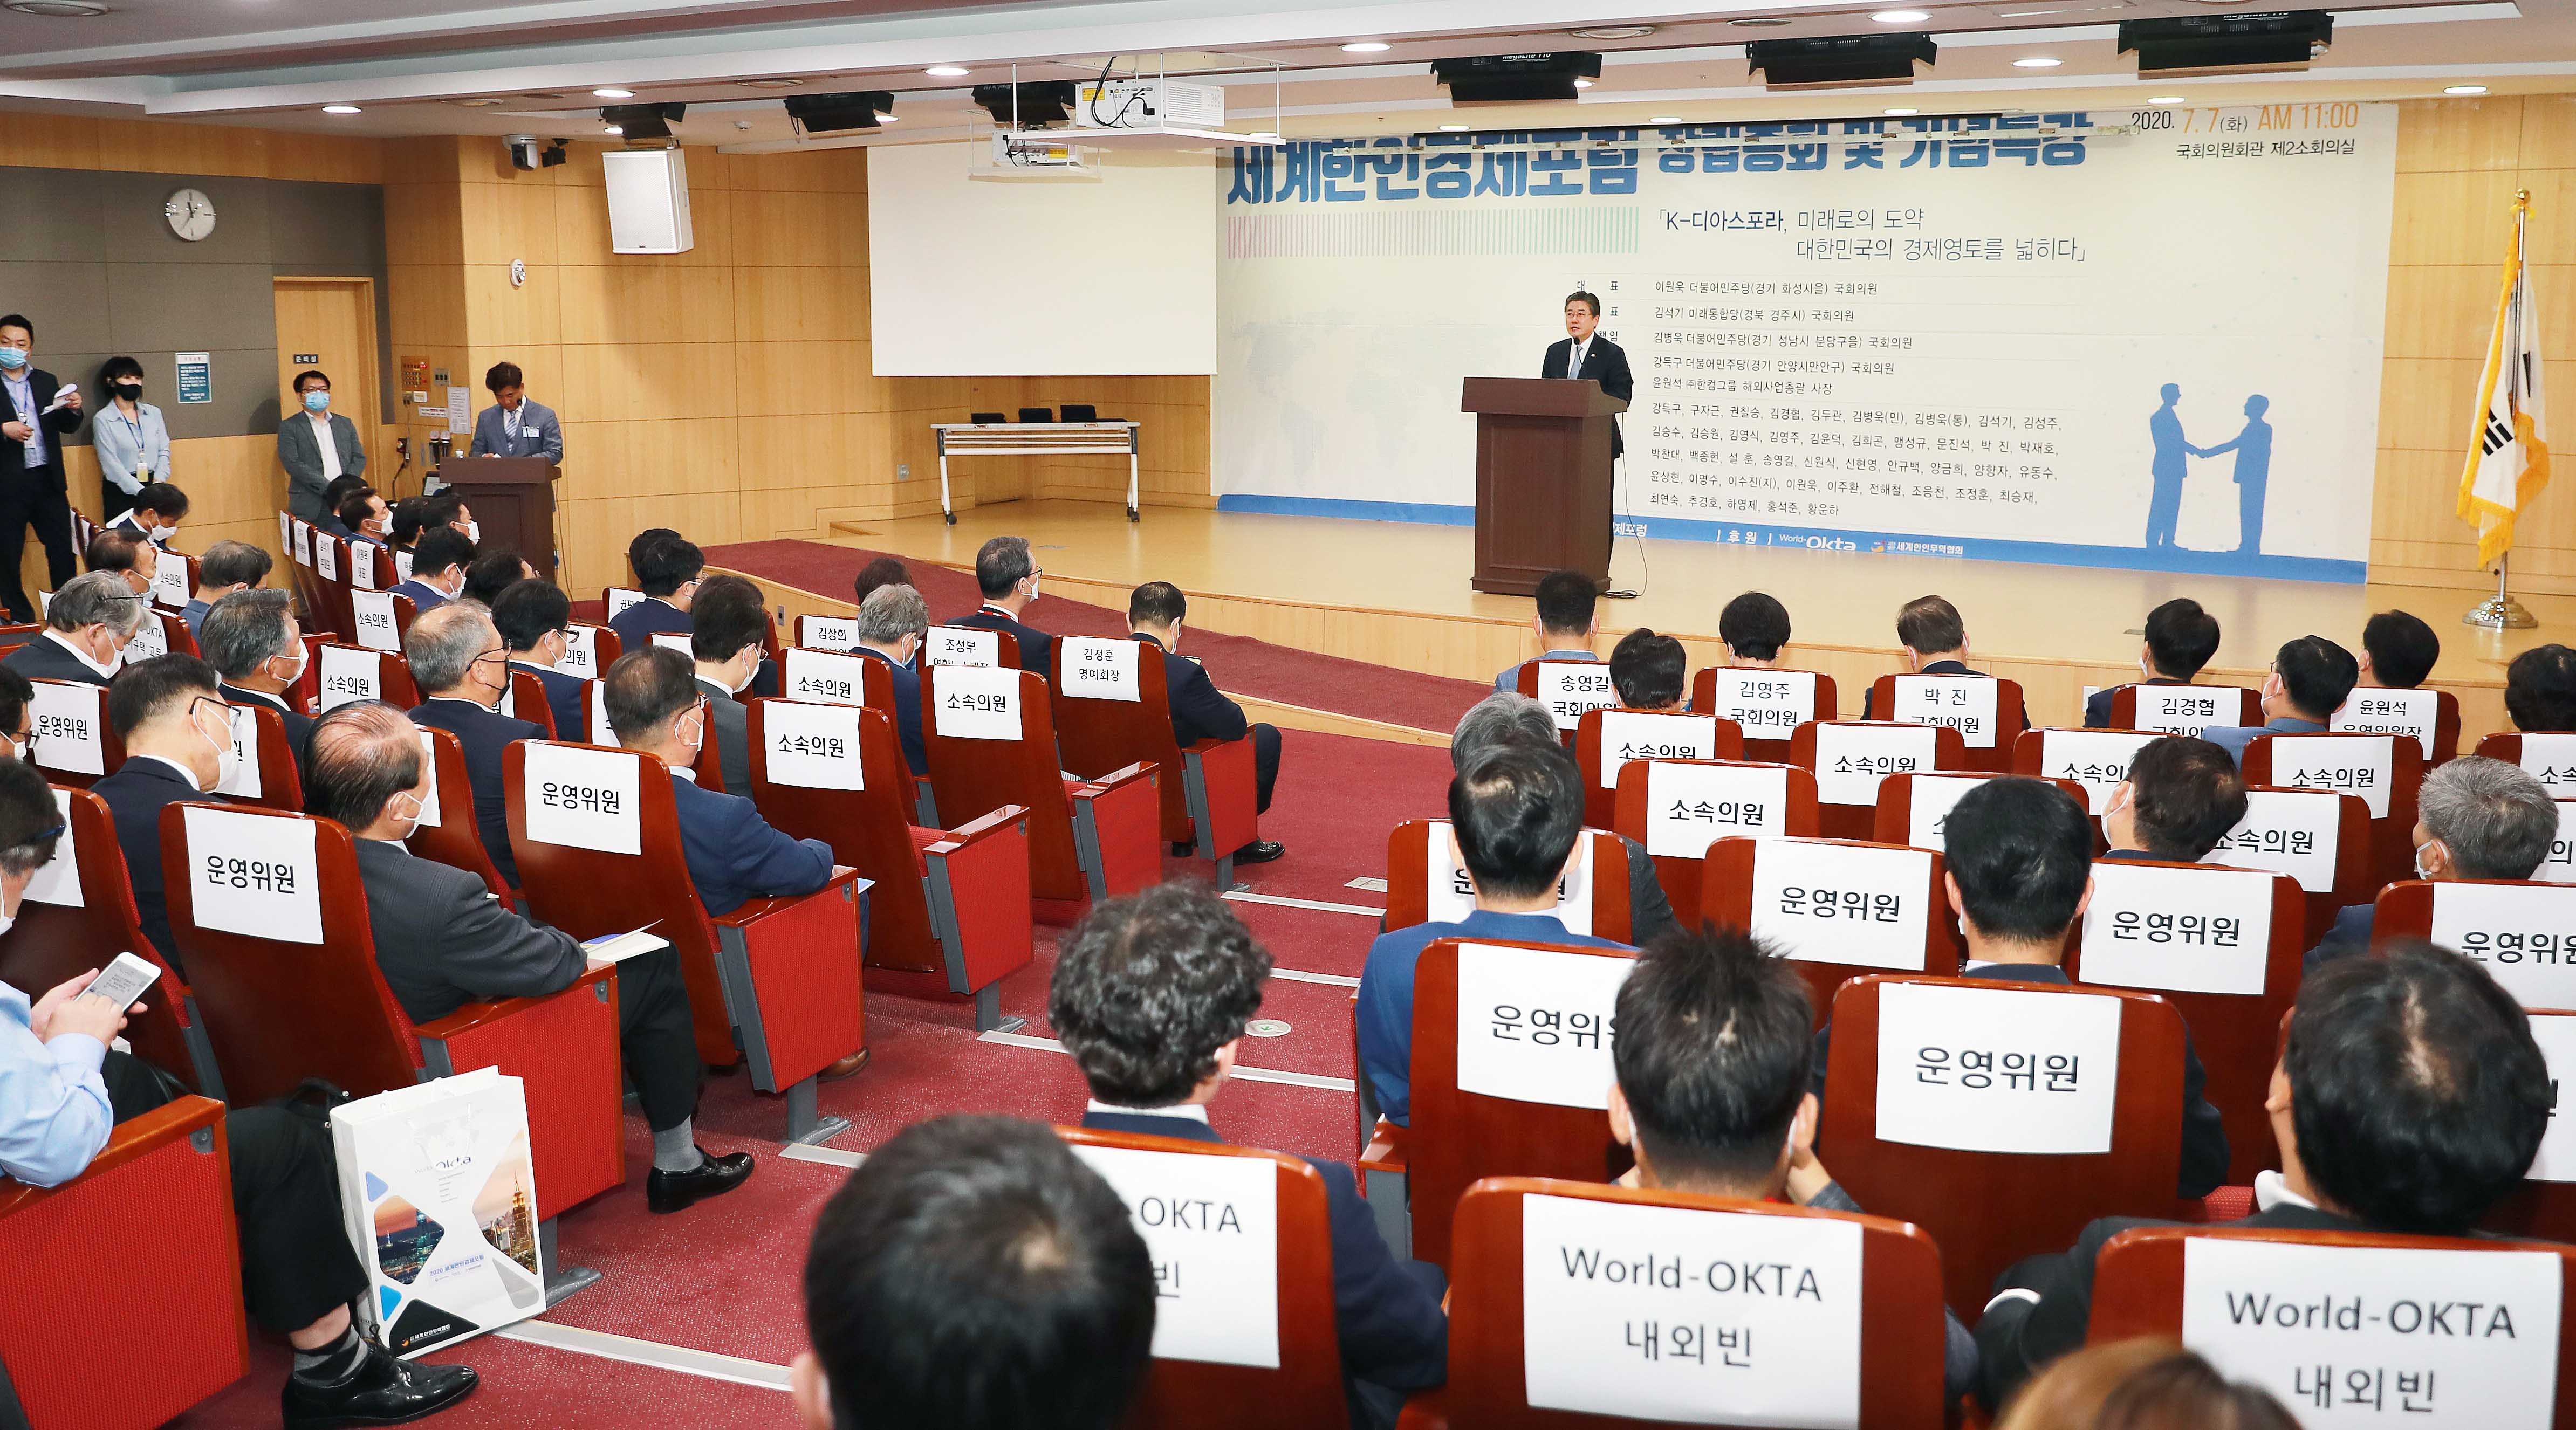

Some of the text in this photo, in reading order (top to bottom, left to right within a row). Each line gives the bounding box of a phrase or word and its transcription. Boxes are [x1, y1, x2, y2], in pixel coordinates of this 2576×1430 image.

[2132, 111, 2175, 130] 2020.
[2257, 105, 2291, 130] AM
[2301, 103, 2359, 129] 11:00
[2176, 139, 2355, 159] 국회의원회관 제2소회의실
[1799, 209, 1874, 231] 미래로의
[1883, 208, 1924, 230] 도약
[1797, 238, 1892, 260] 대한민국의
[1903, 238, 2004, 261] 경제영토를
[1655, 281, 1877, 295] 이원욱 더불어민주당(경기 화성시을) 국회의원
[1655, 307, 1854, 322] 김석기 미래통합당(경북 경주시) 국회의원
[1655, 332, 1912, 349] 김병욱 더불어민주당(경기 성남시 분당구을) 국회의원
[1654, 356, 1894, 375] 강득구 더불어민주당(경기 안양시만안구) 국회의원
[1653, 377, 1681, 389] 윤원석
[1743, 381, 1805, 394] 해외사업총괄
[1811, 383, 1832, 395] 사장
[1653, 403, 2061, 431] 강득구, 구자근, 권칠승, 김경협, 김두관, 김병욱(민), 김병욱(통), 김석기, 김성주,
[1652, 425, 2058, 455] 김승수, 김승원, 김영식, 김영주, 김윤덕, 김희곤, 맹성규, 문진석, 박 진, 박재호,
[1652, 448, 1683, 462] 박찬대,
[1729, 452, 1737, 464] 설
[1763, 454, 1797, 468] 송영길,
[1804, 456, 1838, 470] 신원식,
[1888, 460, 1923, 474] 안규백,
[1930, 462, 1967, 477] 양금희,
[2019, 466, 2057, 480] 유동수,
[1650, 470, 1683, 484] 윤상현,
[1786, 479, 1820, 492] 이원욱,
[1827, 480, 1862, 495] 이주환,
[1869, 483, 1904, 497] 전해철,
[1911, 485, 1948, 499] 조응천,
[1955, 488, 1992, 502] 조정훈,
[1999, 490, 2037, 504] 최승재,
[1650, 493, 1682, 507] 최연숙,
[1688, 496, 1721, 510] 추경호,
[1727, 498, 1760, 512] 하영제,
[1807, 503, 1839, 516] 황운하
[1614, 522, 1647, 537] 제포럼
[359, 612, 389, 628] 소속의원
[818, 627, 846, 642] 김상희
[945, 638, 976, 654] 조성부
[566, 649, 586, 666] 의원
[1084, 649, 1114, 662] 김정훈
[327, 674, 369, 697] 소속의원
[1079, 668, 1120, 682] 명예회장
[1561, 675, 1608, 692] 송영길
[798, 676, 851, 699] 소속의원
[1740, 682, 1790, 699] 김영주
[1925, 689, 1966, 706] 박 진
[947, 693, 1006, 712] 소속의원
[2162, 698, 2214, 716] 김경협
[2360, 700, 2406, 717] 윤원석
[38, 714, 88, 740] 운영위원
[1729, 708, 1797, 727] 국회의원
[778, 734, 844, 758] 소속의원
[2062, 762, 2125, 783] 소속의
[2292, 768, 2375, 788] 소속의원
[2540, 765, 2576, 785] 소속
[542, 782, 619, 814] 운영위원
[1669, 800, 1763, 826] 소속의원
[2215, 829, 2314, 855] 소속의원
[207, 855, 295, 894] 운영위원
[1780, 887, 1900, 923] 운영위원
[2112, 911, 2239, 947] 운영위원
[1490, 1005, 1617, 1050] 운영위
[1916, 1048, 2078, 1092] 운영위원
[1562, 1247, 1821, 1302] World-OKTA
[2228, 1292, 2516, 1339] World-OKTA
[1626, 1322, 1750, 1367] 내외빈
[2294, 1365, 2435, 1413] 내외빈
